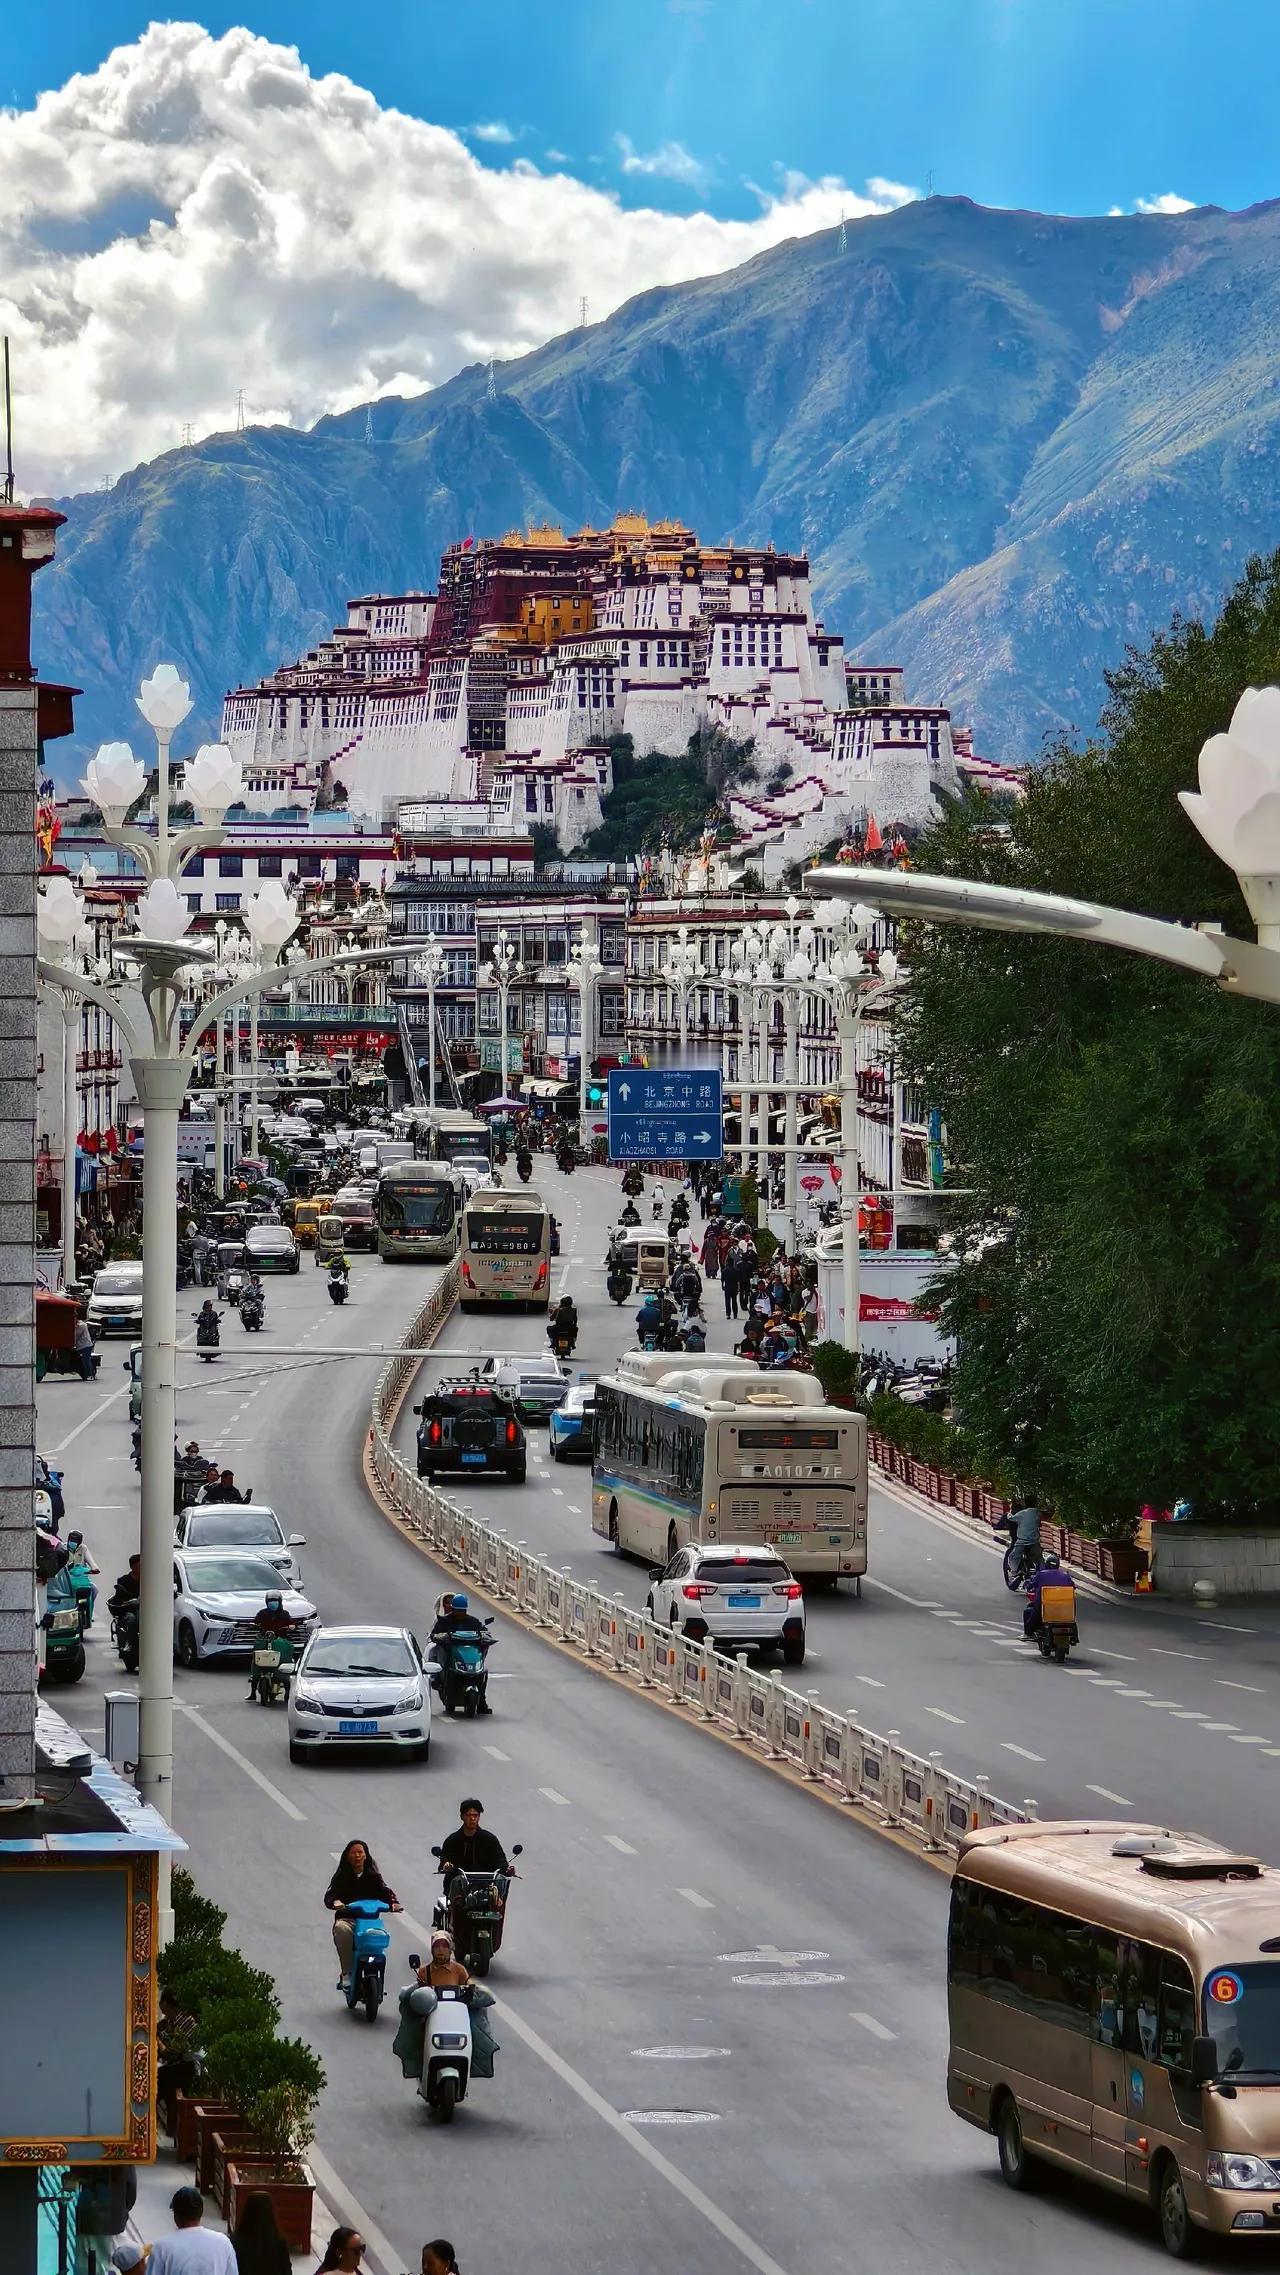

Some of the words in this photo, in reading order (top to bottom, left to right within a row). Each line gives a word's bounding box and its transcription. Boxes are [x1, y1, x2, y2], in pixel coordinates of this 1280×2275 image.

[644, 1085, 713, 1098] 北京中路
[695, 1099, 714, 1108] ROAD
[619, 1131, 687, 1144] 小昭寺路
[619, 1146, 657, 1155] XIAOZHAOSI
[665, 1146, 684, 1155] ROAD
[1216, 1979, 1233, 1998] 6
